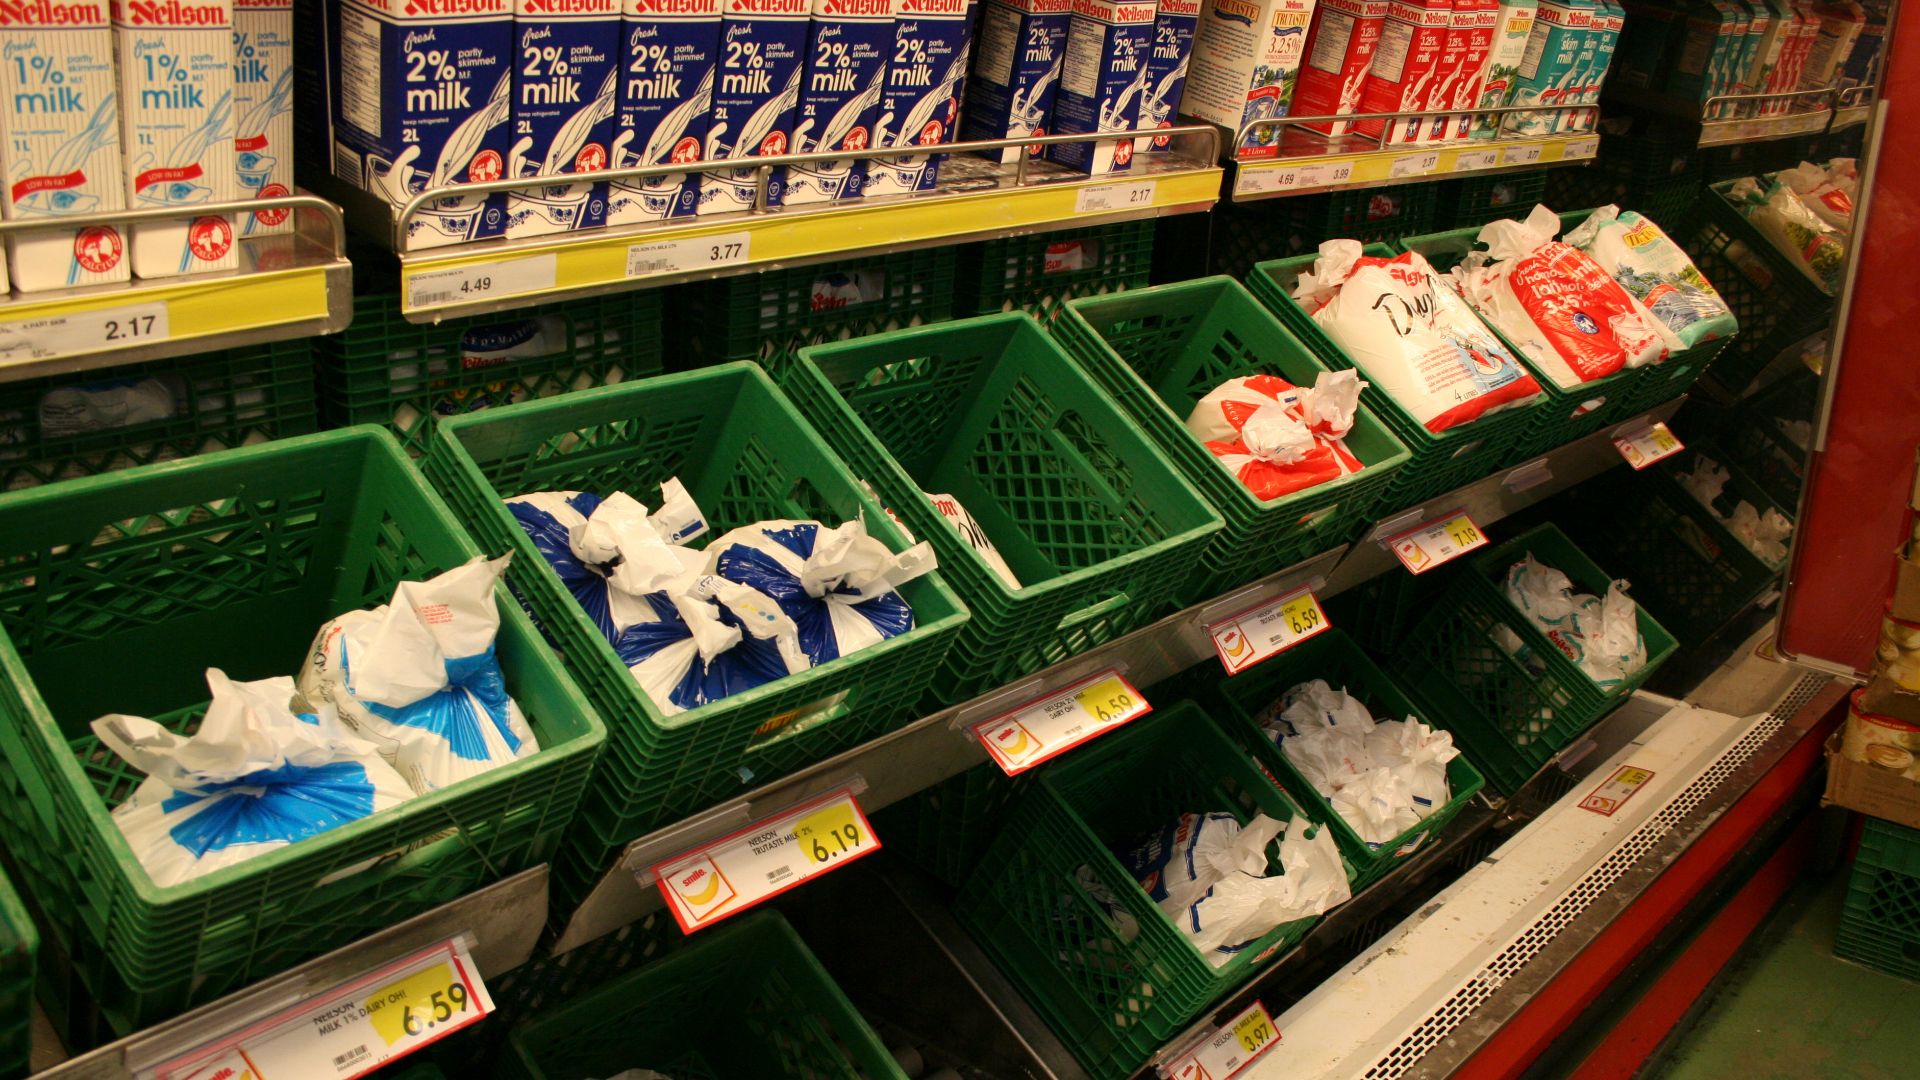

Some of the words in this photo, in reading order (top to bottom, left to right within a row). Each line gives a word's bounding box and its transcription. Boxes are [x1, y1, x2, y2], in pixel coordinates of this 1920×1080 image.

[129, 0, 226, 26] Neilson
[1117, 7, 1153, 22] Neilson
[1275, 13, 1308, 26] TRUTASTE
[1425, 13, 1448, 24] Neilson
[1453, 15, 1474, 26] Neilson
[1475, 12, 1496, 24] Neilson
[1568, 12, 1591, 25] Neilson
[523, 25, 551, 48] fresh
[631, 25, 658, 46] fresh
[726, 23, 752, 43] fresh
[818, 25, 841, 44] fresh
[896, 22, 918, 40] fresh
[1029, 29, 1049, 45] 2%
[1156, 28, 1176, 44] 2%
[3, 37, 37, 60] fresh
[134, 37, 165, 58] fresh
[404, 28, 436, 53] fresh
[674, 44, 695, 54] partly
[766, 42, 785, 52] partly
[853, 43, 872, 52] partly
[928, 39, 944, 48] partly
[1114, 38, 1134, 55] 2%
[1268, 37, 1301, 54] 3.25%
[1561, 38, 1578, 50] skim
[458, 48, 483, 59] partly
[571, 45, 593, 55] partly
[571, 53, 605, 63] skimmed
[673, 52, 705, 62] skimmed
[724, 41, 763, 68] 2%
[765, 50, 794, 59] skimmed
[815, 42, 850, 68] 2%
[852, 50, 879, 59] skimmed
[894, 39, 926, 64] 2%
[1026, 46, 1052, 62] milk
[1153, 44, 1180, 59] milk
[1416, 52, 1430, 63] milk
[1557, 51, 1573, 64] milk
[406, 50, 456, 82] 2%
[458, 56, 496, 67] skimmed
[523, 46, 568, 76] 2%
[630, 45, 671, 73] 2%
[1111, 56, 1137, 72] milk
[14, 56, 64, 84] 1%
[144, 54, 188, 82] 1%
[890, 64, 932, 87] milk
[627, 74, 682, 100] milk
[721, 70, 772, 94] milk
[811, 68, 858, 92] milk
[142, 84, 205, 110] milk
[407, 81, 471, 112] milk
[523, 76, 581, 105] milk
[15, 87, 85, 113] milk
[883, 98, 896, 110] 2L
[714, 106, 729, 120] 2L
[803, 105, 816, 116] 2L
[517, 120, 533, 134] 2L
[621, 114, 635, 126] 2L
[138, 134, 154, 145] 1L
[402, 128, 420, 142] 2L
[14, 140, 30, 151] 1L
[1422, 157, 1436, 168] 2.37
[1527, 151, 1540, 160] 3.77
[1278, 174, 1294, 185] 4.69
[1333, 169, 1349, 180] 3.99
[1130, 189, 1150, 202] 2.17
[193, 242, 229, 260] CALCIUM
[710, 243, 742, 261] 3.77
[80, 252, 120, 272] CALCIUM
[460, 277, 492, 294] 4.49
[105, 315, 156, 341] 2.17
[1454, 389, 1463, 403] 4
[1454, 527, 1479, 547] 7.19
[1293, 608, 1318, 634] 6.59
[1095, 694, 1132, 722] 6.59
[748, 830, 778, 847] NEILSON
[752, 838, 784, 856] TRUTASTE
[784, 831, 800, 844] MILK
[801, 826, 813, 836] 2%
[812, 823, 860, 863] 6.19
[682, 867, 707, 887] smile.
[313, 1001, 356, 1025] NEILSON
[319, 1020, 342, 1037] MILK
[343, 1013, 358, 1025] 1%
[359, 1000, 387, 1017] DAIRY
[388, 990, 408, 1004] OH!
[402, 982, 468, 1036] 6.59
[1213, 1030, 1234, 1049] NEILSON
[1244, 1022, 1270, 1052] 3.97
